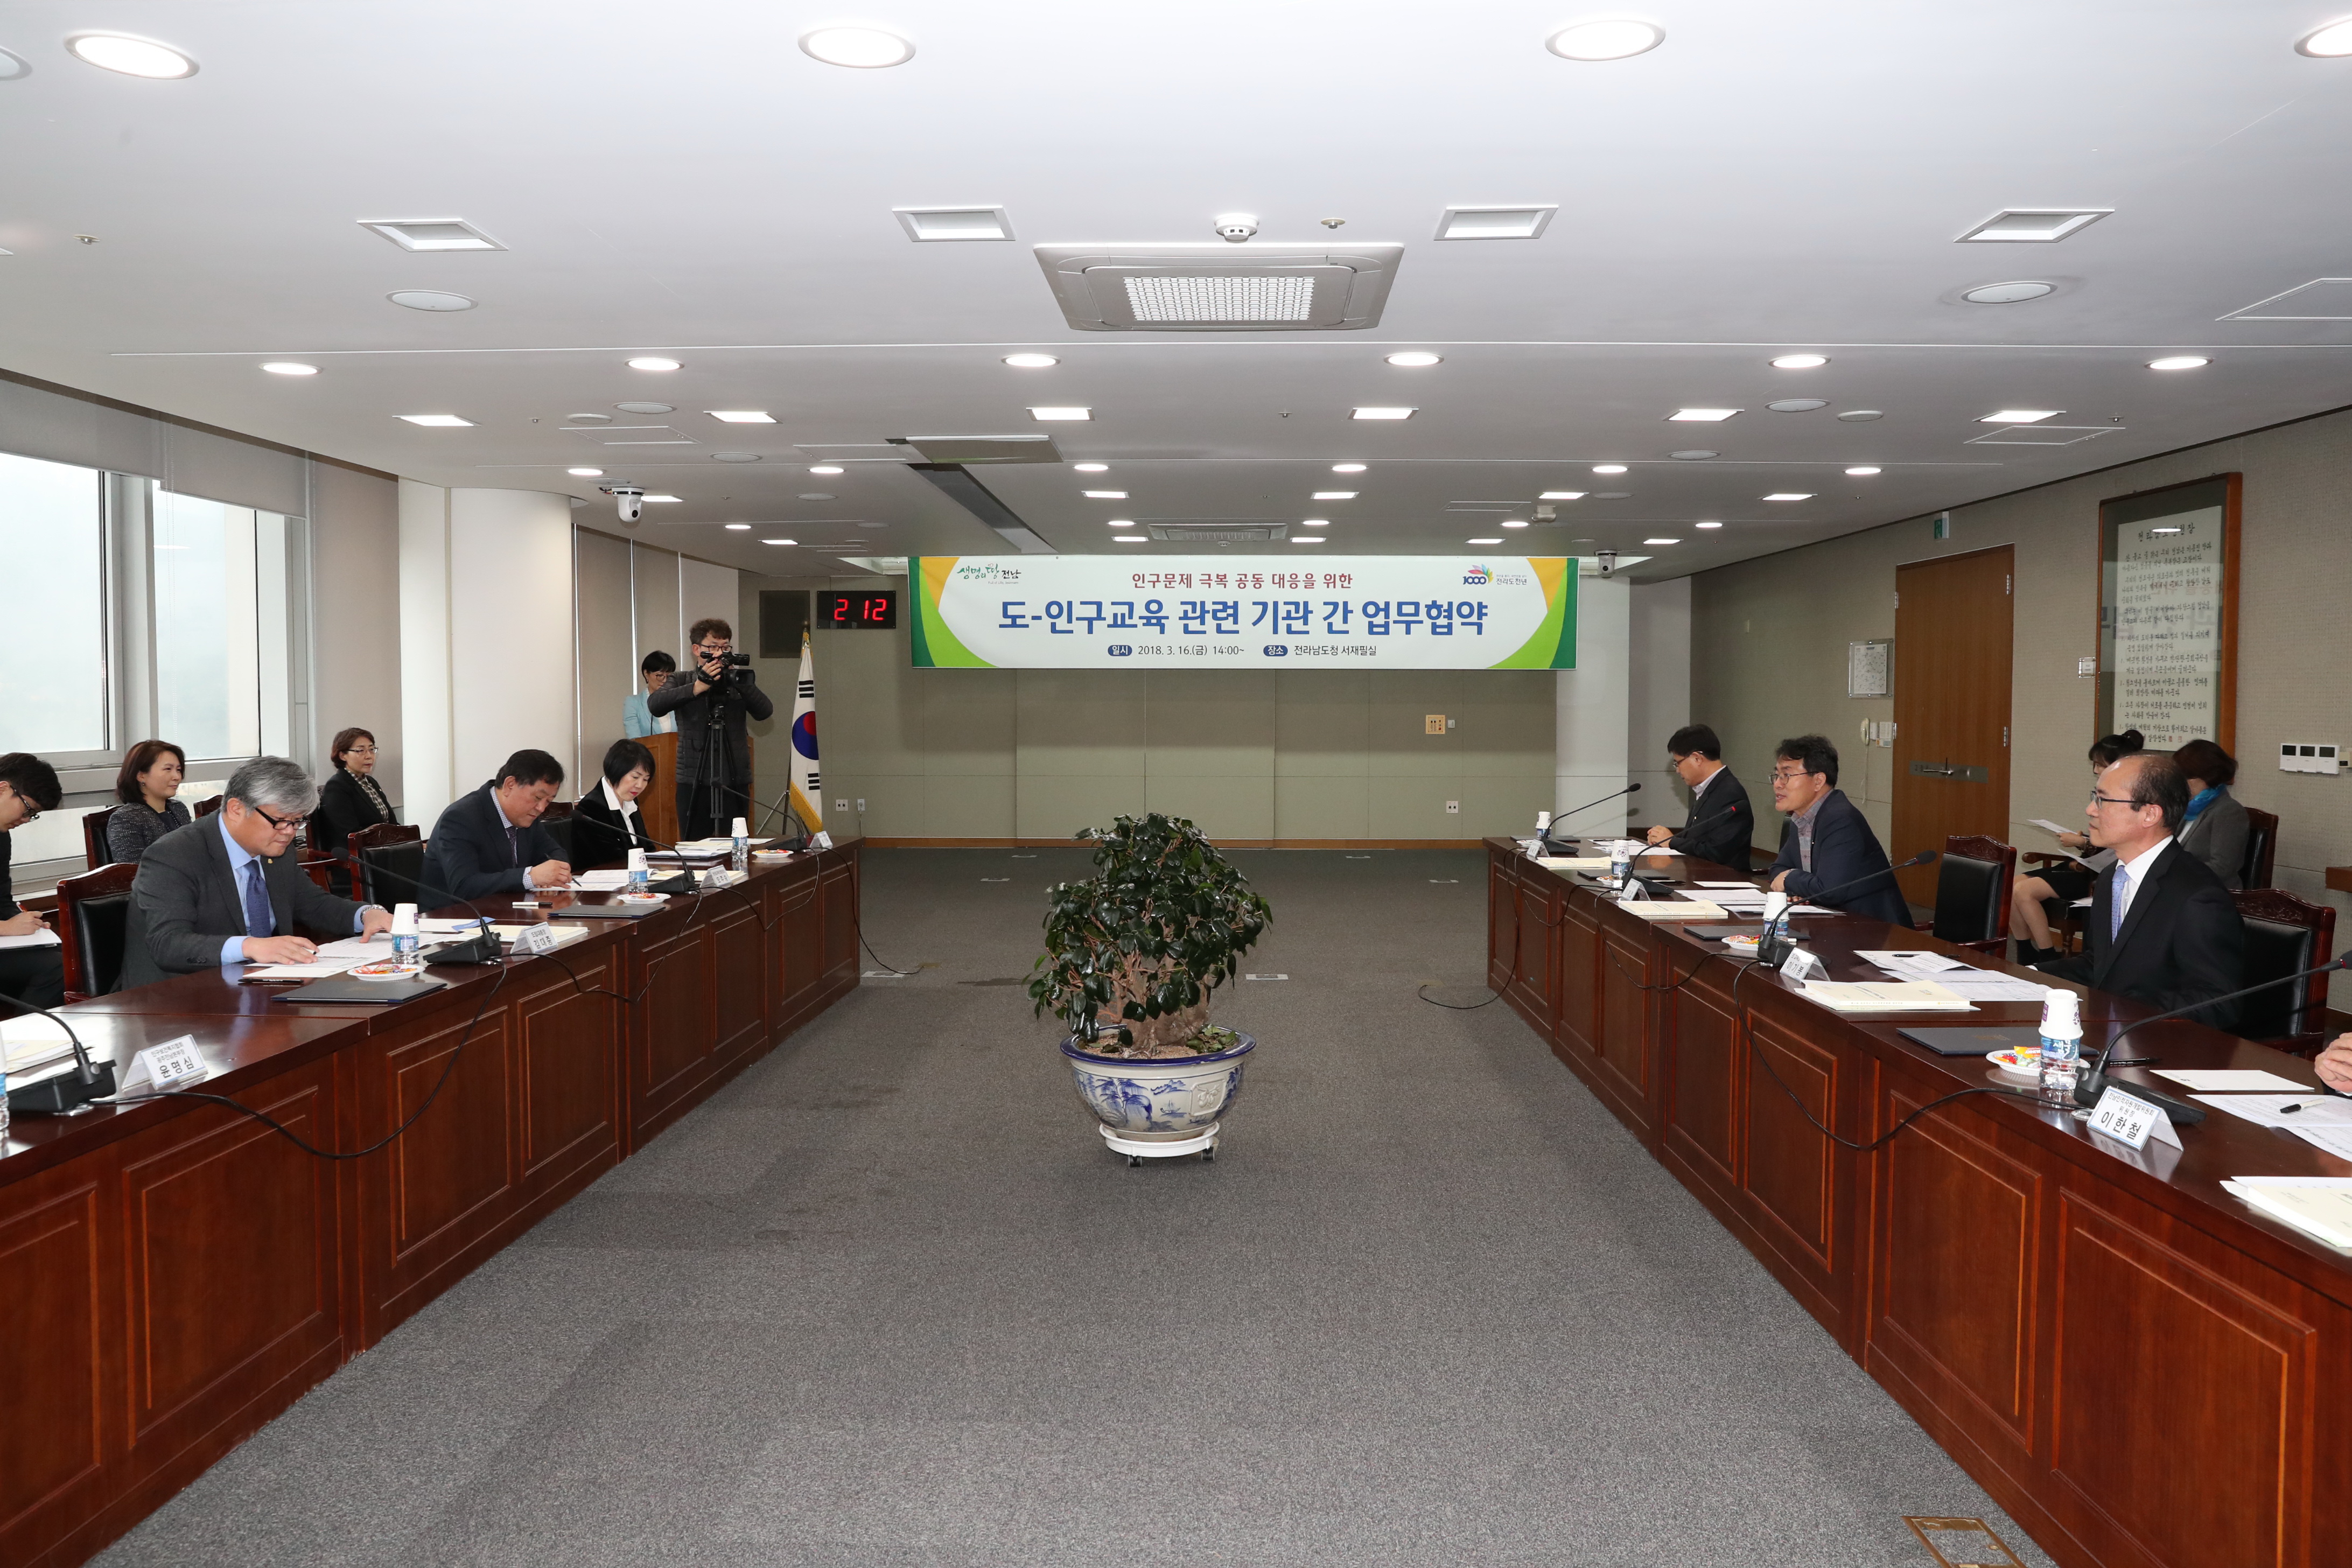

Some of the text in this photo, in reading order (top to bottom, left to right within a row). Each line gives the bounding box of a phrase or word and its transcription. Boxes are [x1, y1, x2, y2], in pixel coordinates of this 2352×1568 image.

[1002, 569, 1021, 579] 전남
[1132, 573, 1353, 589] 인구문제 극복 공동 대응을 위한
[1462, 576, 1487, 585] 1000
[999, 599, 1488, 635] 도-인구교육 관련 기관 간 업무협약
[1111, 645, 1244, 656] 일시 2018. 3. 16.(금) 14:00~
[1268, 645, 1376, 656] 장소 전라남도청 서재필실
[534, 936, 552, 949] 김대중
[151, 1042, 184, 1057] 인구보건복지협회
[156, 1049, 185, 1063] 광주전남본부장
[2108, 1093, 2154, 1116] 전남인적자원개발위원회
[2101, 1111, 2141, 1140] 이한철
